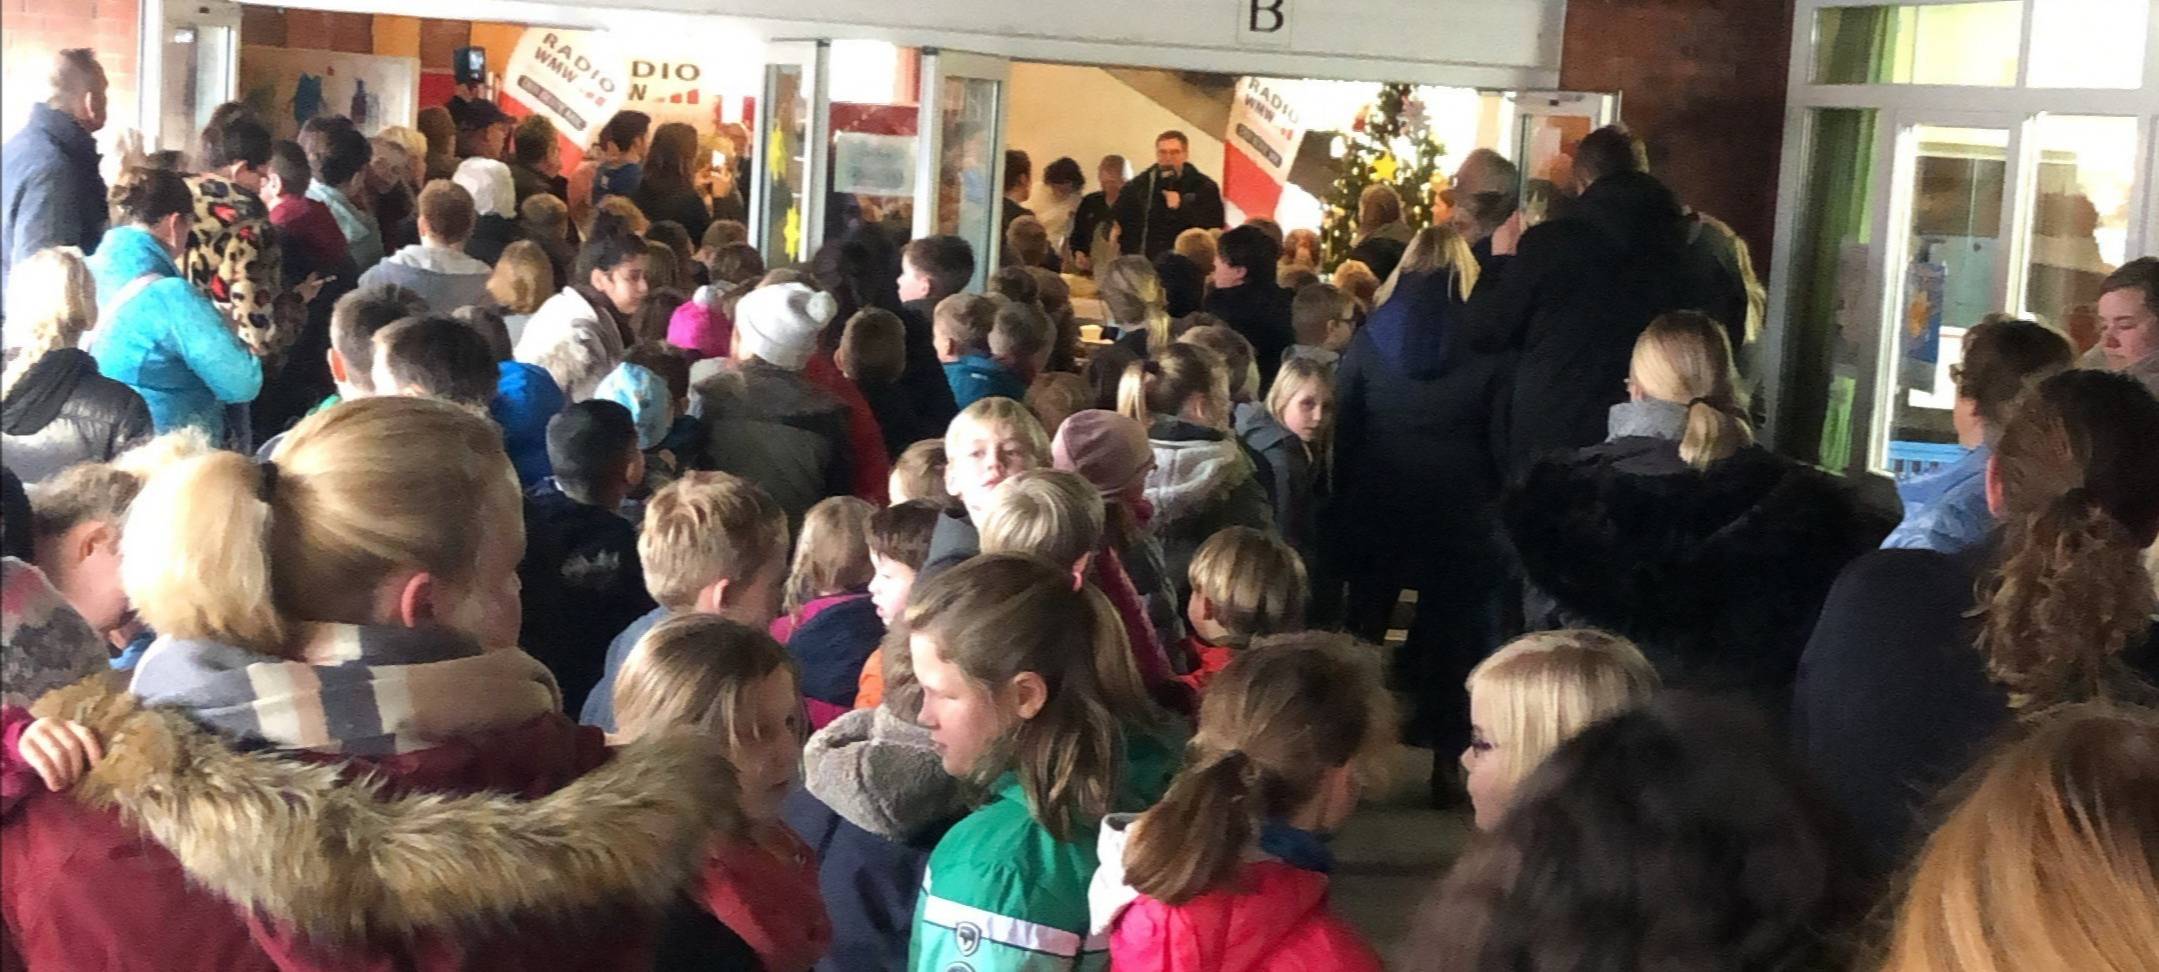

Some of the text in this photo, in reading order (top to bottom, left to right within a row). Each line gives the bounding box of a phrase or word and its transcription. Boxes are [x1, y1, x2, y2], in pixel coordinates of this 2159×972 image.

[1249, 0, 1284, 32] B
[534, 47, 577, 83] WMW
[542, 33, 616, 92] RADIO
[632, 61, 700, 81] DIO
